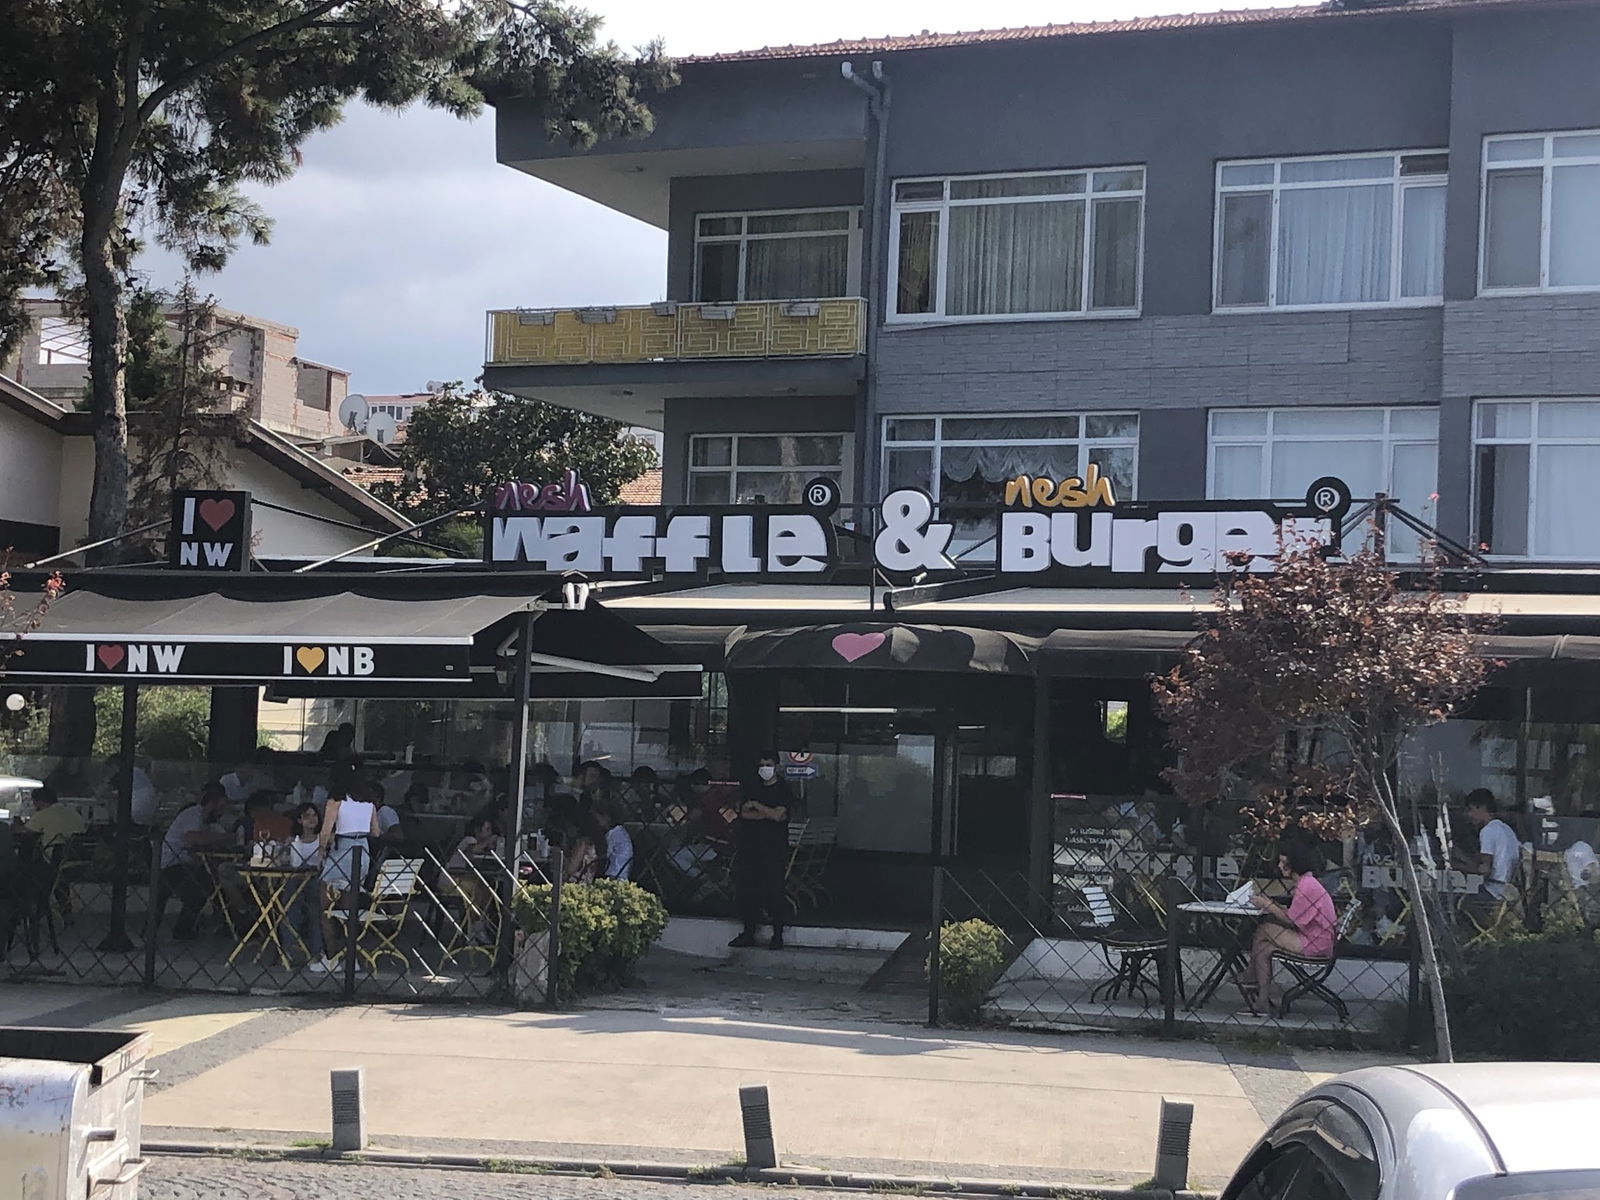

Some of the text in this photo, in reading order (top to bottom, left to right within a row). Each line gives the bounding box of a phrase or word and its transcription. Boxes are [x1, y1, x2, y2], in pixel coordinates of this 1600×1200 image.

[495, 469, 592, 512] nesh
[1005, 463, 1116, 508] nesh
[182, 497, 196, 535] I
[874, 489, 957, 573] &
[180, 541, 234, 568] NW
[127, 644, 186, 673] NW
[327, 646, 375, 676] NB
